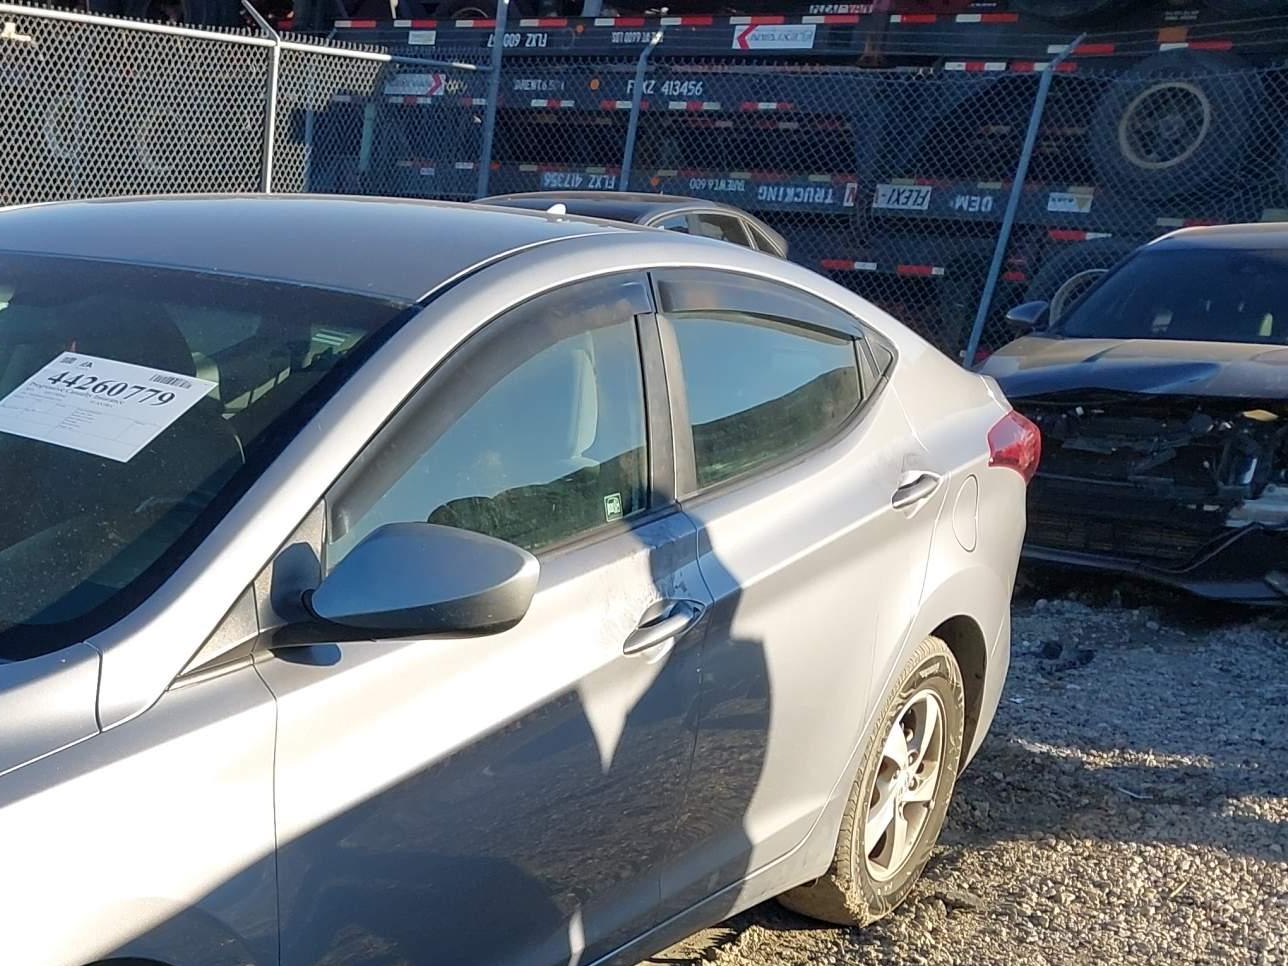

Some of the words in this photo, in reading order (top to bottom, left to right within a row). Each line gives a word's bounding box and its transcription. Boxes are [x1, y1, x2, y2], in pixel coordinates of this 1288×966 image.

[526, 33, 548, 48] FLXZ
[626, 80, 656, 95] FXZ
[661, 80, 703, 97] 413456
[543, 173, 583, 190] 417356
[588, 175, 616, 190] FLXZ
[757, 185, 834, 205] TRUCKING
[47, 371, 176, 407] 44260779
